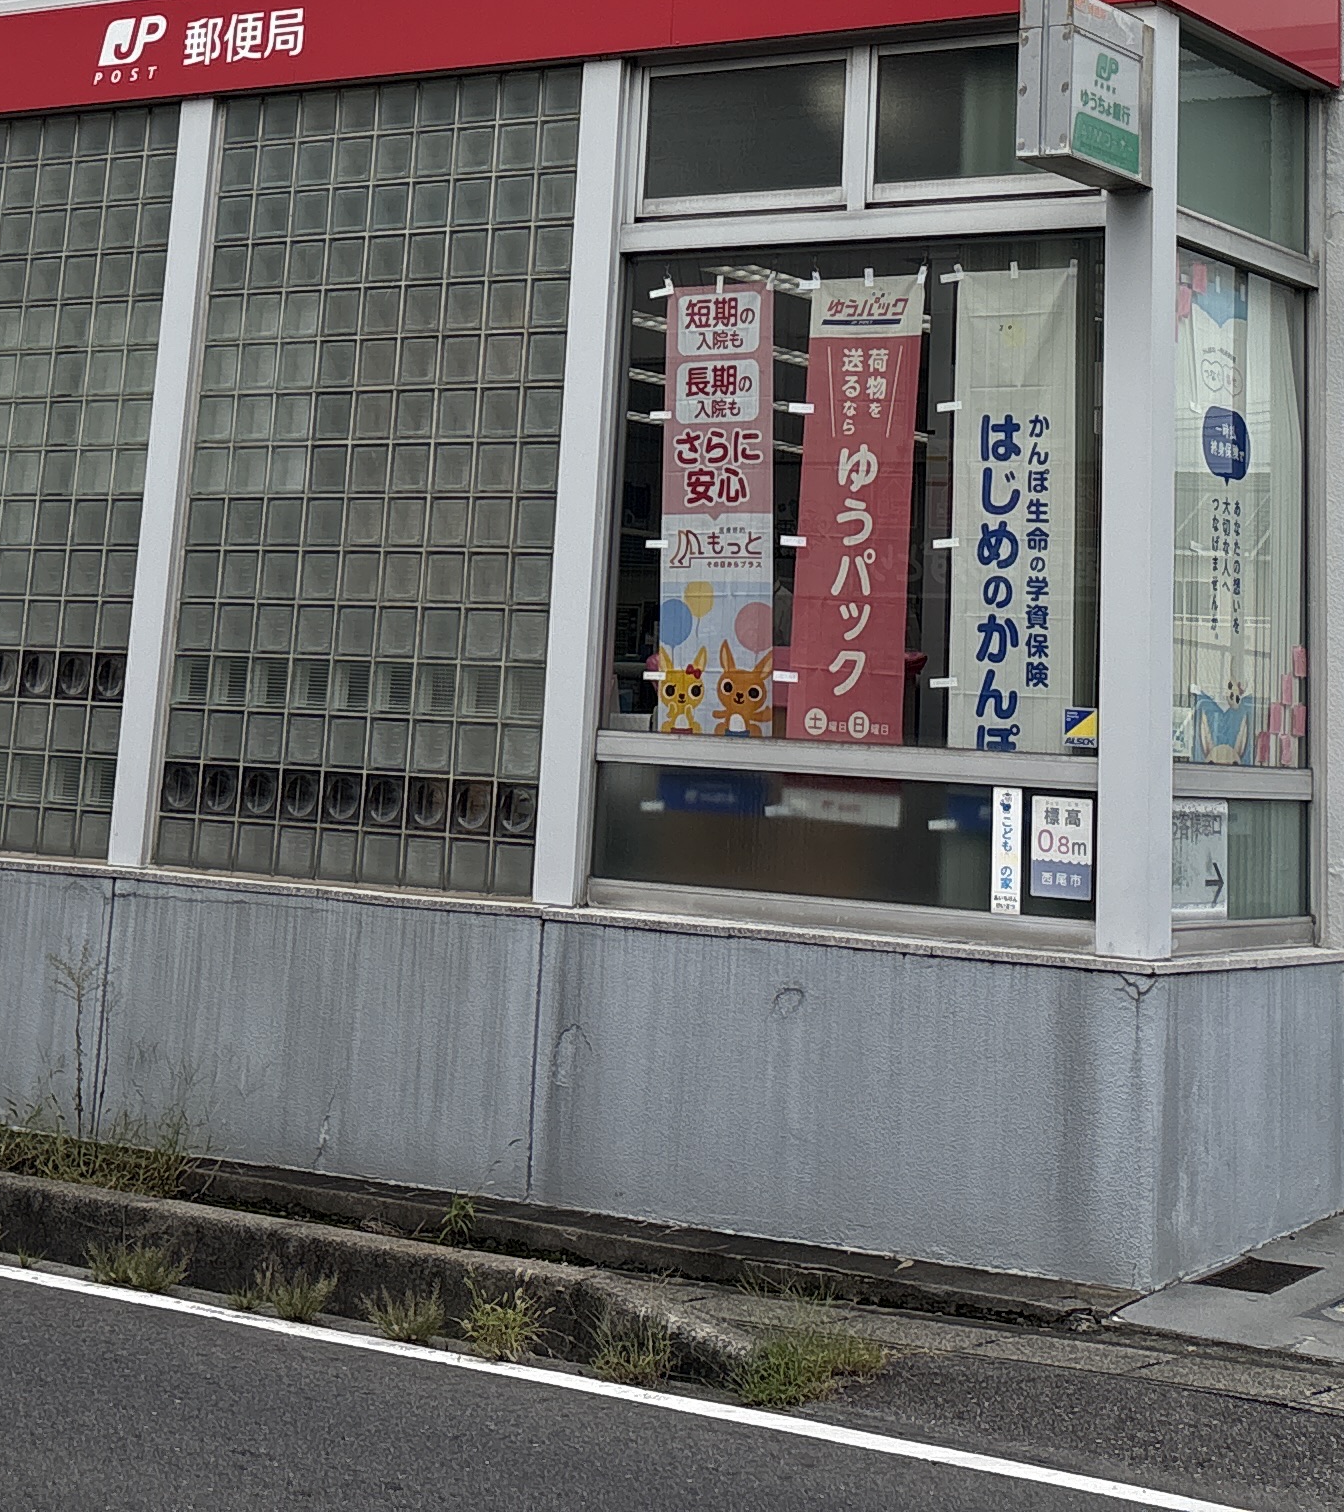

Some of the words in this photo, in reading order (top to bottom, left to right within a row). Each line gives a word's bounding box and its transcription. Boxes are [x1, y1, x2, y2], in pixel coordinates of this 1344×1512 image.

[182, 8, 305, 66] 郵便局
[93, 66, 157, 85] POST
[1080, 89, 1131, 126] ゆうちょ銀行
[685, 297, 756, 329] 短期の
[827, 298, 908, 317] ゆうパック
[696, 331, 744, 351] 入院も
[685, 365, 753, 397] 長期の
[841, 347, 864, 435] 送るなら
[866, 348, 889, 418] 荷物を
[694, 399, 741, 419] 入院も
[675, 430, 761, 465] さらに
[686, 467, 748, 505] 安心
[707, 531, 762, 555] もっと
[1025, 414, 1050, 688] かんぽ生命の学資保険
[1221, 496, 1231, 592] 大切な人へ
[706, 560, 763, 568] その日からプラス
[828, 443, 879, 696] ゆうパック
[976, 414, 1022, 751] はじめのかんぽ
[1044, 807, 1082, 828] 標高
[1041, 871, 1083, 888] 西尾市
